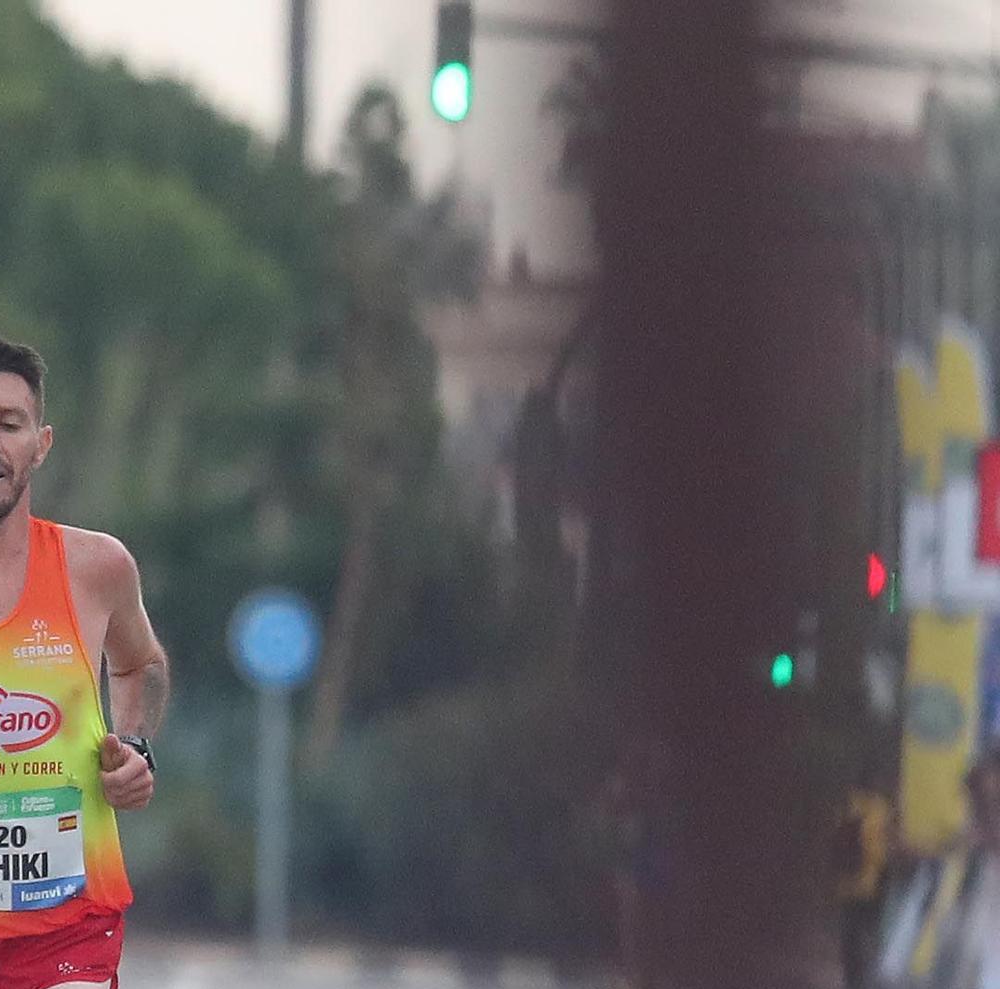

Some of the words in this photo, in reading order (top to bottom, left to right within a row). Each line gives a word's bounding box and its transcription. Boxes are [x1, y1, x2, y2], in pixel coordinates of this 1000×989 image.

[13, 644, 72, 658] SERRANO
[11, 762, 19, 775] Y
[23, 761, 64, 775] CORRE
